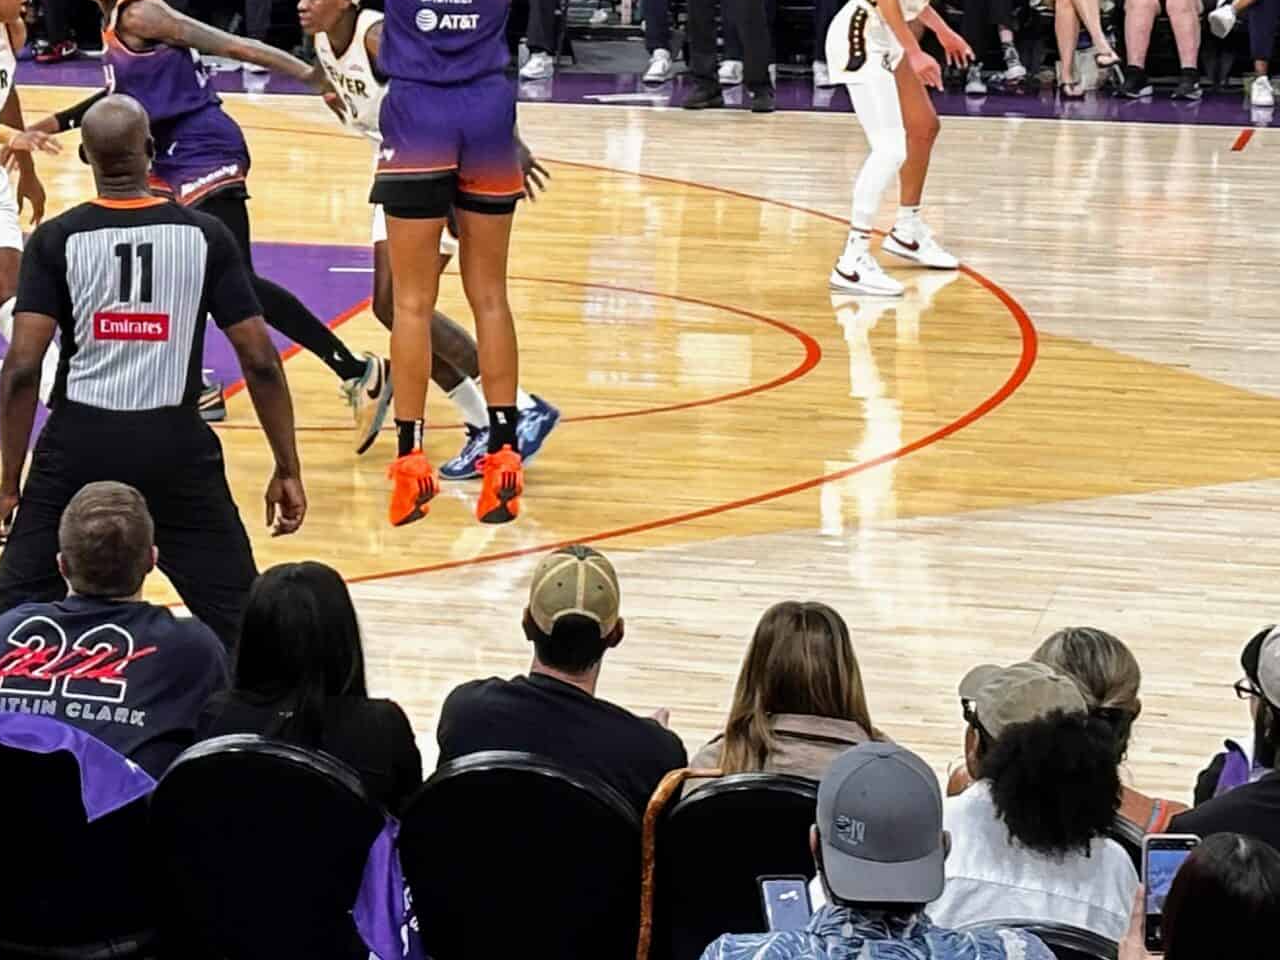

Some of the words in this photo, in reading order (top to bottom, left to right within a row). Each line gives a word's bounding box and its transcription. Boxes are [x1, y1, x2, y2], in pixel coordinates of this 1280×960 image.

[439, 14, 479, 29] AT&T
[115, 243, 153, 303] 11
[100, 319, 162, 334] Emirates
[66, 702, 146, 727] CLARK
